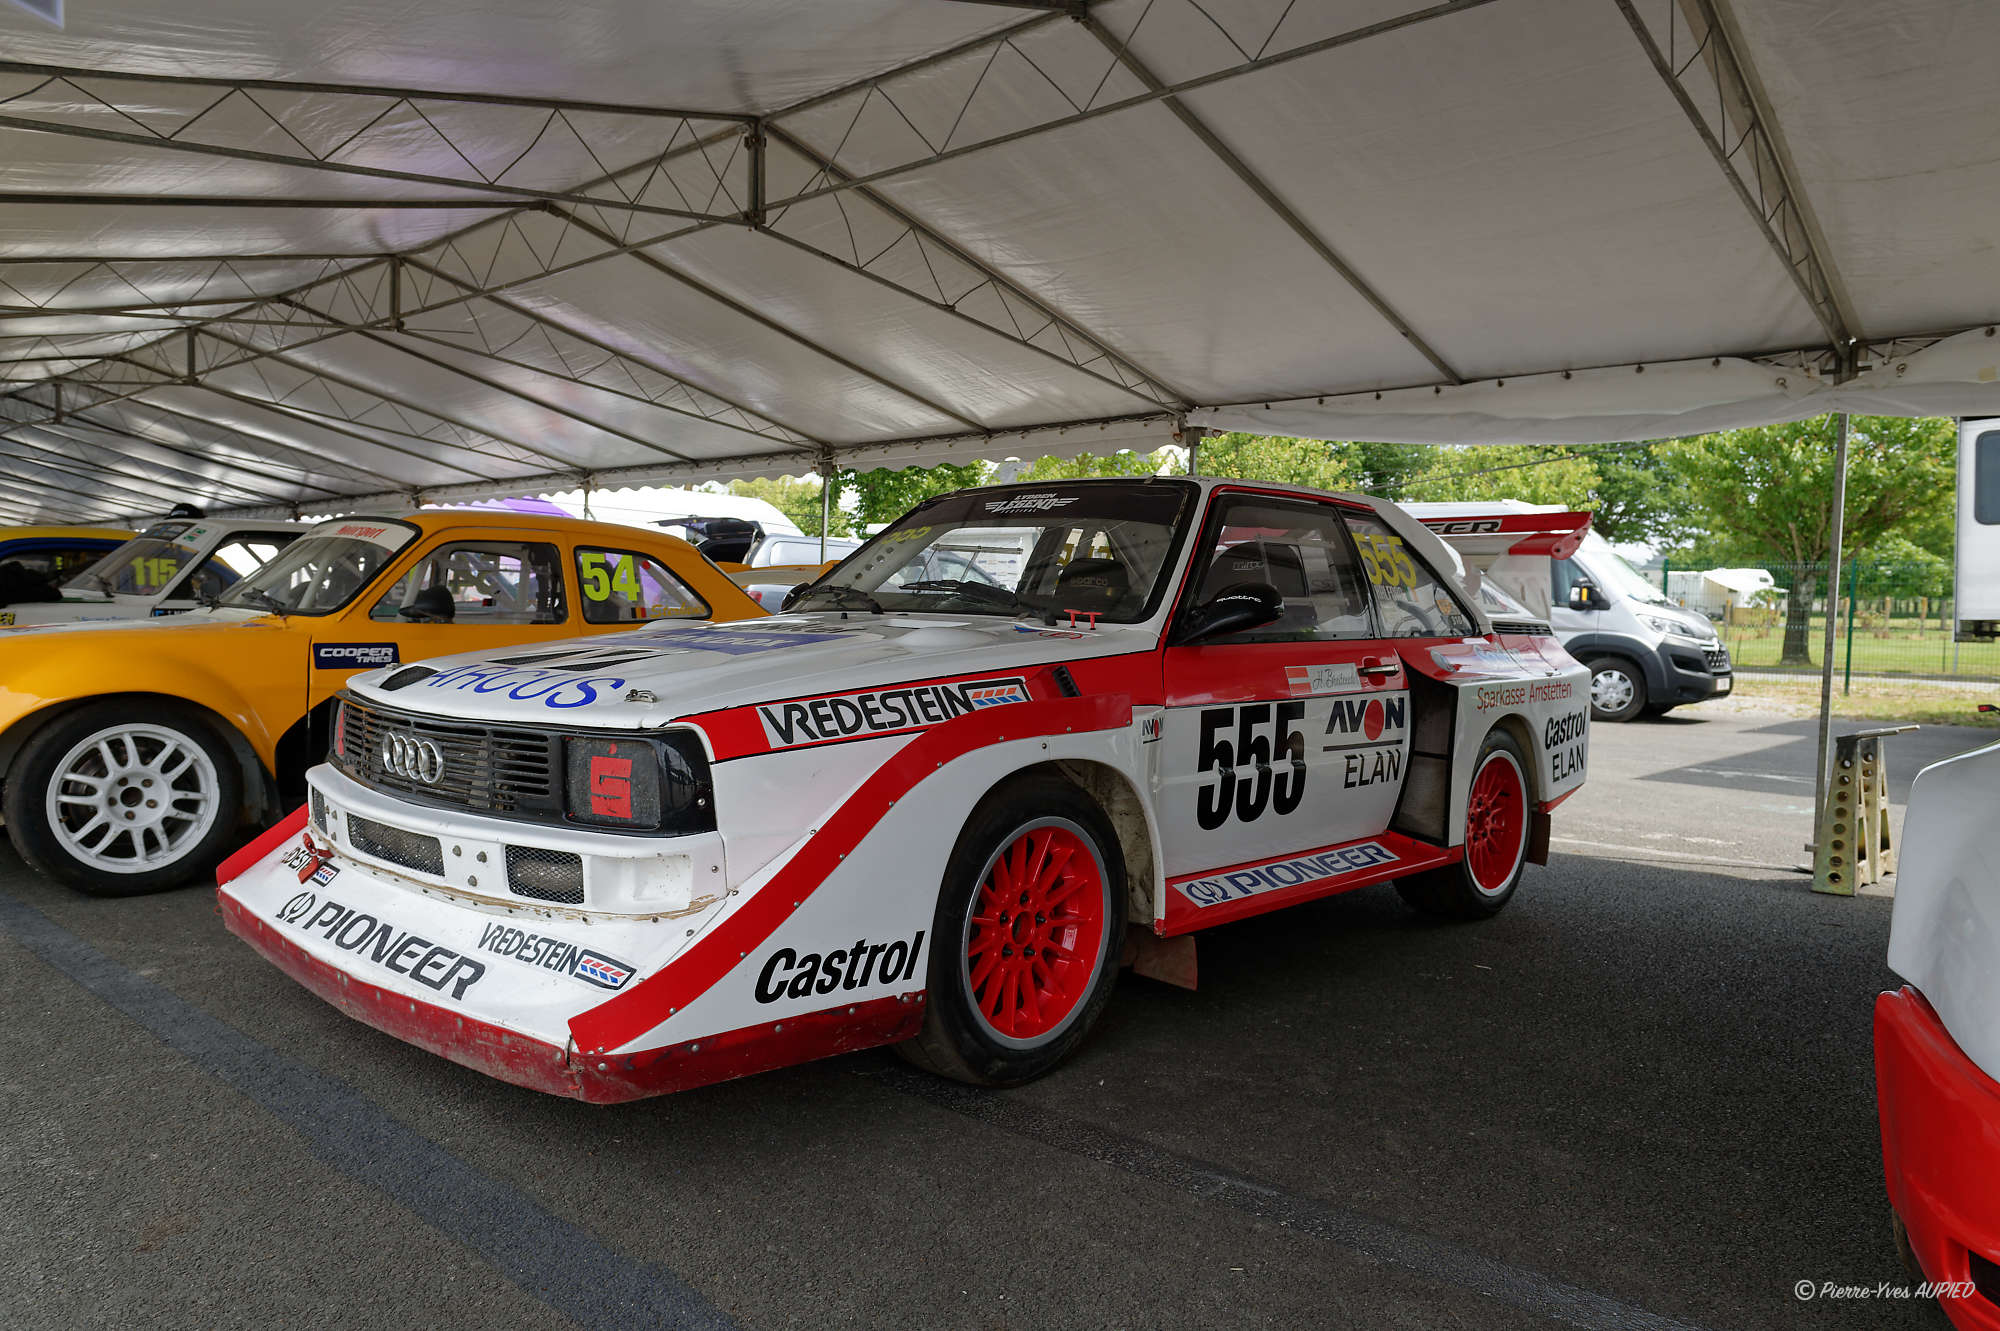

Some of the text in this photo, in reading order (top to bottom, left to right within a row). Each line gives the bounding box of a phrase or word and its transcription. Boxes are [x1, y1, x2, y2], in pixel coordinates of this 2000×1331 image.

[991, 498, 1059, 512] LEGEND
[131, 557, 177, 587] 115
[580, 553, 641, 602] 54
[1352, 532, 1416, 588] 555
[1216, 595, 1262, 603] quattro
[319, 647, 394, 657] COOPER
[355, 655, 393, 664] TIRES
[427, 663, 626, 709] ARCUS
[1477, 682, 1572, 714] Sparkasse Amstetten
[755, 683, 974, 744] VREDESTEIN
[1325, 697, 1404, 741] AVON
[1544, 705, 1588, 750] Castrol
[1195, 701, 1306, 831] 555
[1343, 749, 1401, 789] ELAN
[1552, 743, 1585, 782] ELAN
[1223, 843, 1397, 894] PIONEER
[302, 900, 487, 1001] PIONEER
[477, 921, 588, 977] VREDESTEIN
[753, 931, 926, 1004] Castrol
